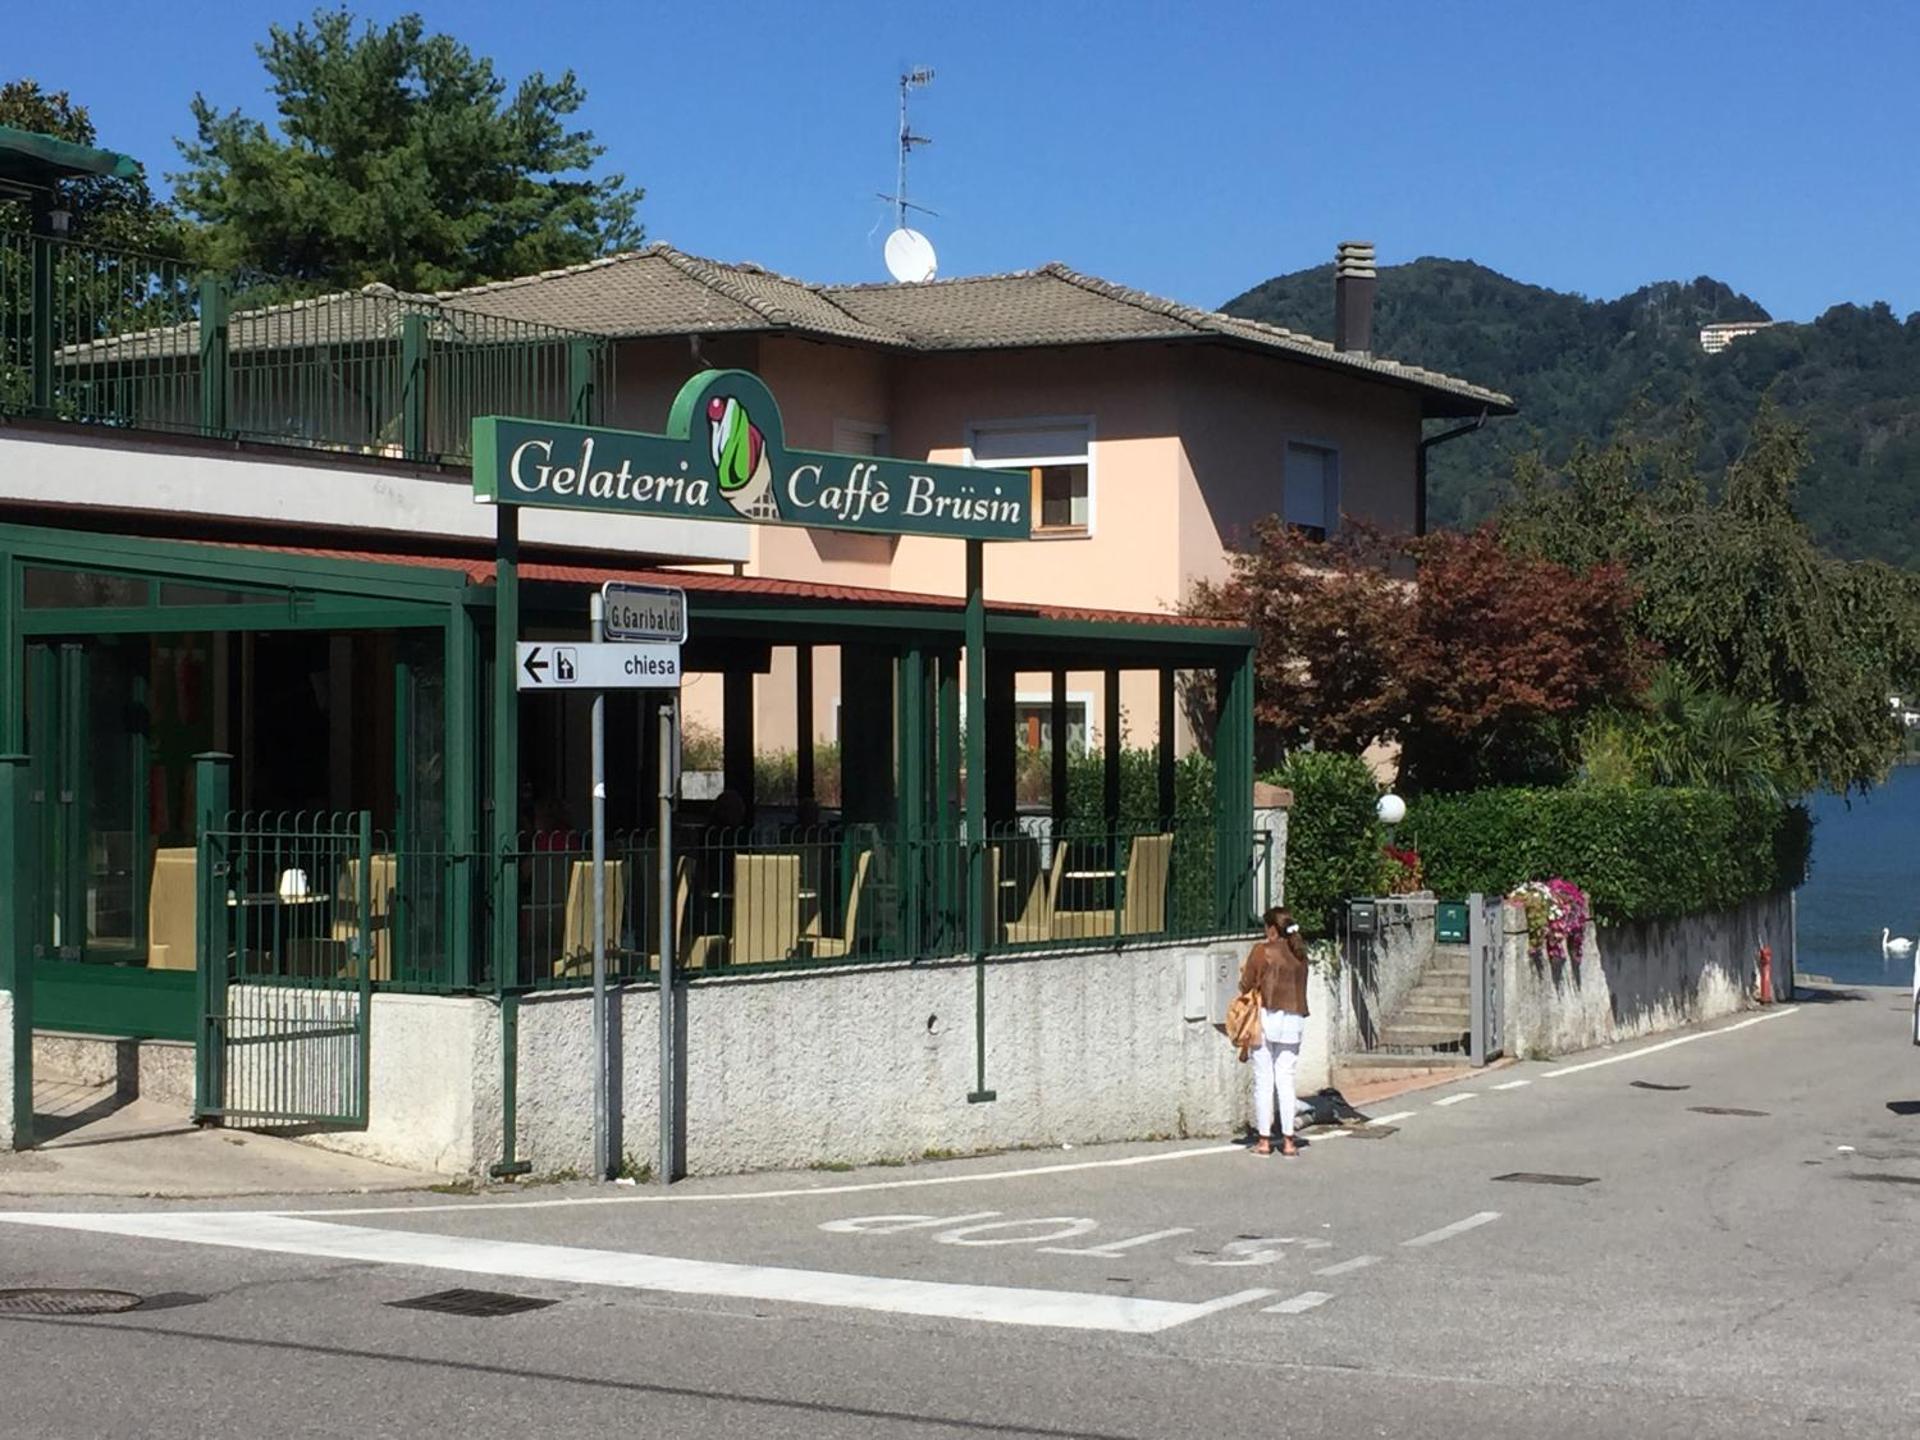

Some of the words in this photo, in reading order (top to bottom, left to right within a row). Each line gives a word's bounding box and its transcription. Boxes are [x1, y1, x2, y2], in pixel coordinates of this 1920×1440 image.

[510, 437, 709, 506] Gelateria
[787, 462, 891, 522] Caffè
[902, 475, 1021, 524] Brüsin
[624, 654, 675, 675] chiesa
[817, 1211, 1333, 1267] STOP
